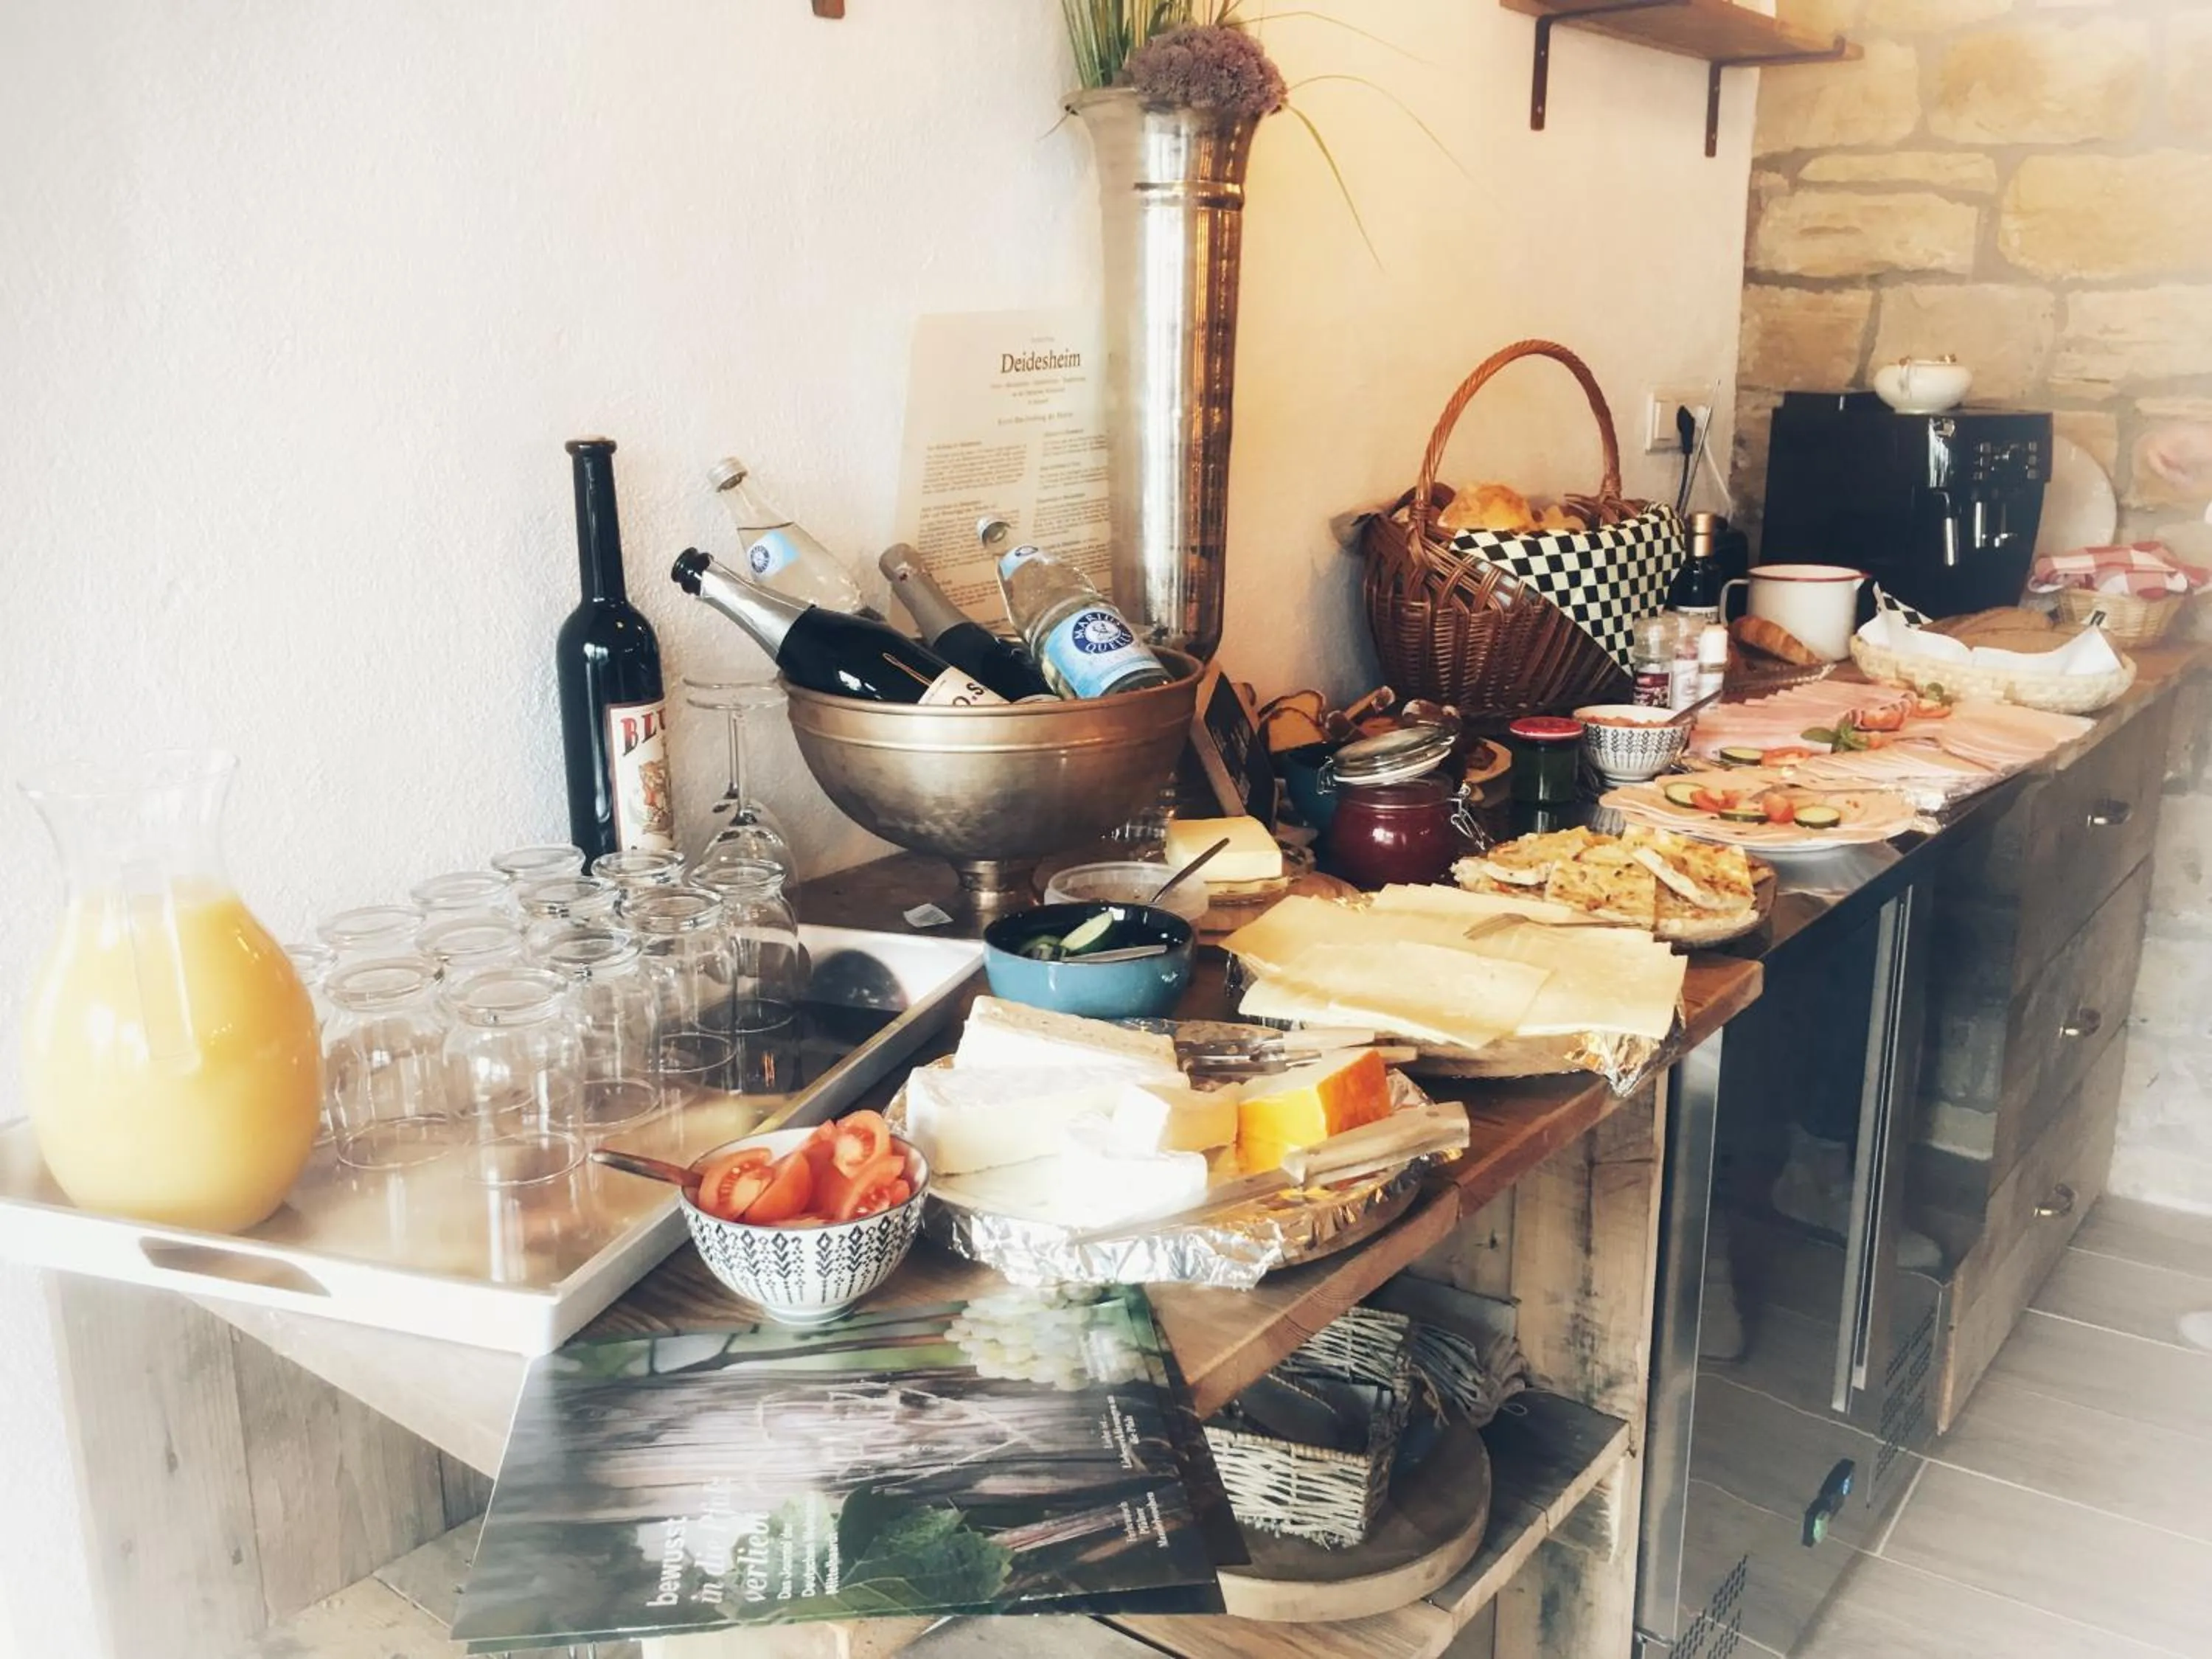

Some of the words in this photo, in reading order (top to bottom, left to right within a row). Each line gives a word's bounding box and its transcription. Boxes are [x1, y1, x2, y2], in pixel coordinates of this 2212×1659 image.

[1001, 348, 1081, 374] Deidesheim
[646, 1516, 687, 1607] bewusst
[695, 1540, 726, 1576] die
[737, 1512, 771, 1602] verliebt
[779, 1540, 793, 1579] Journal
[801, 1543, 815, 1597] Deutschen
[691, 1582, 724, 1604] in
[777, 1580, 793, 1599] Das
